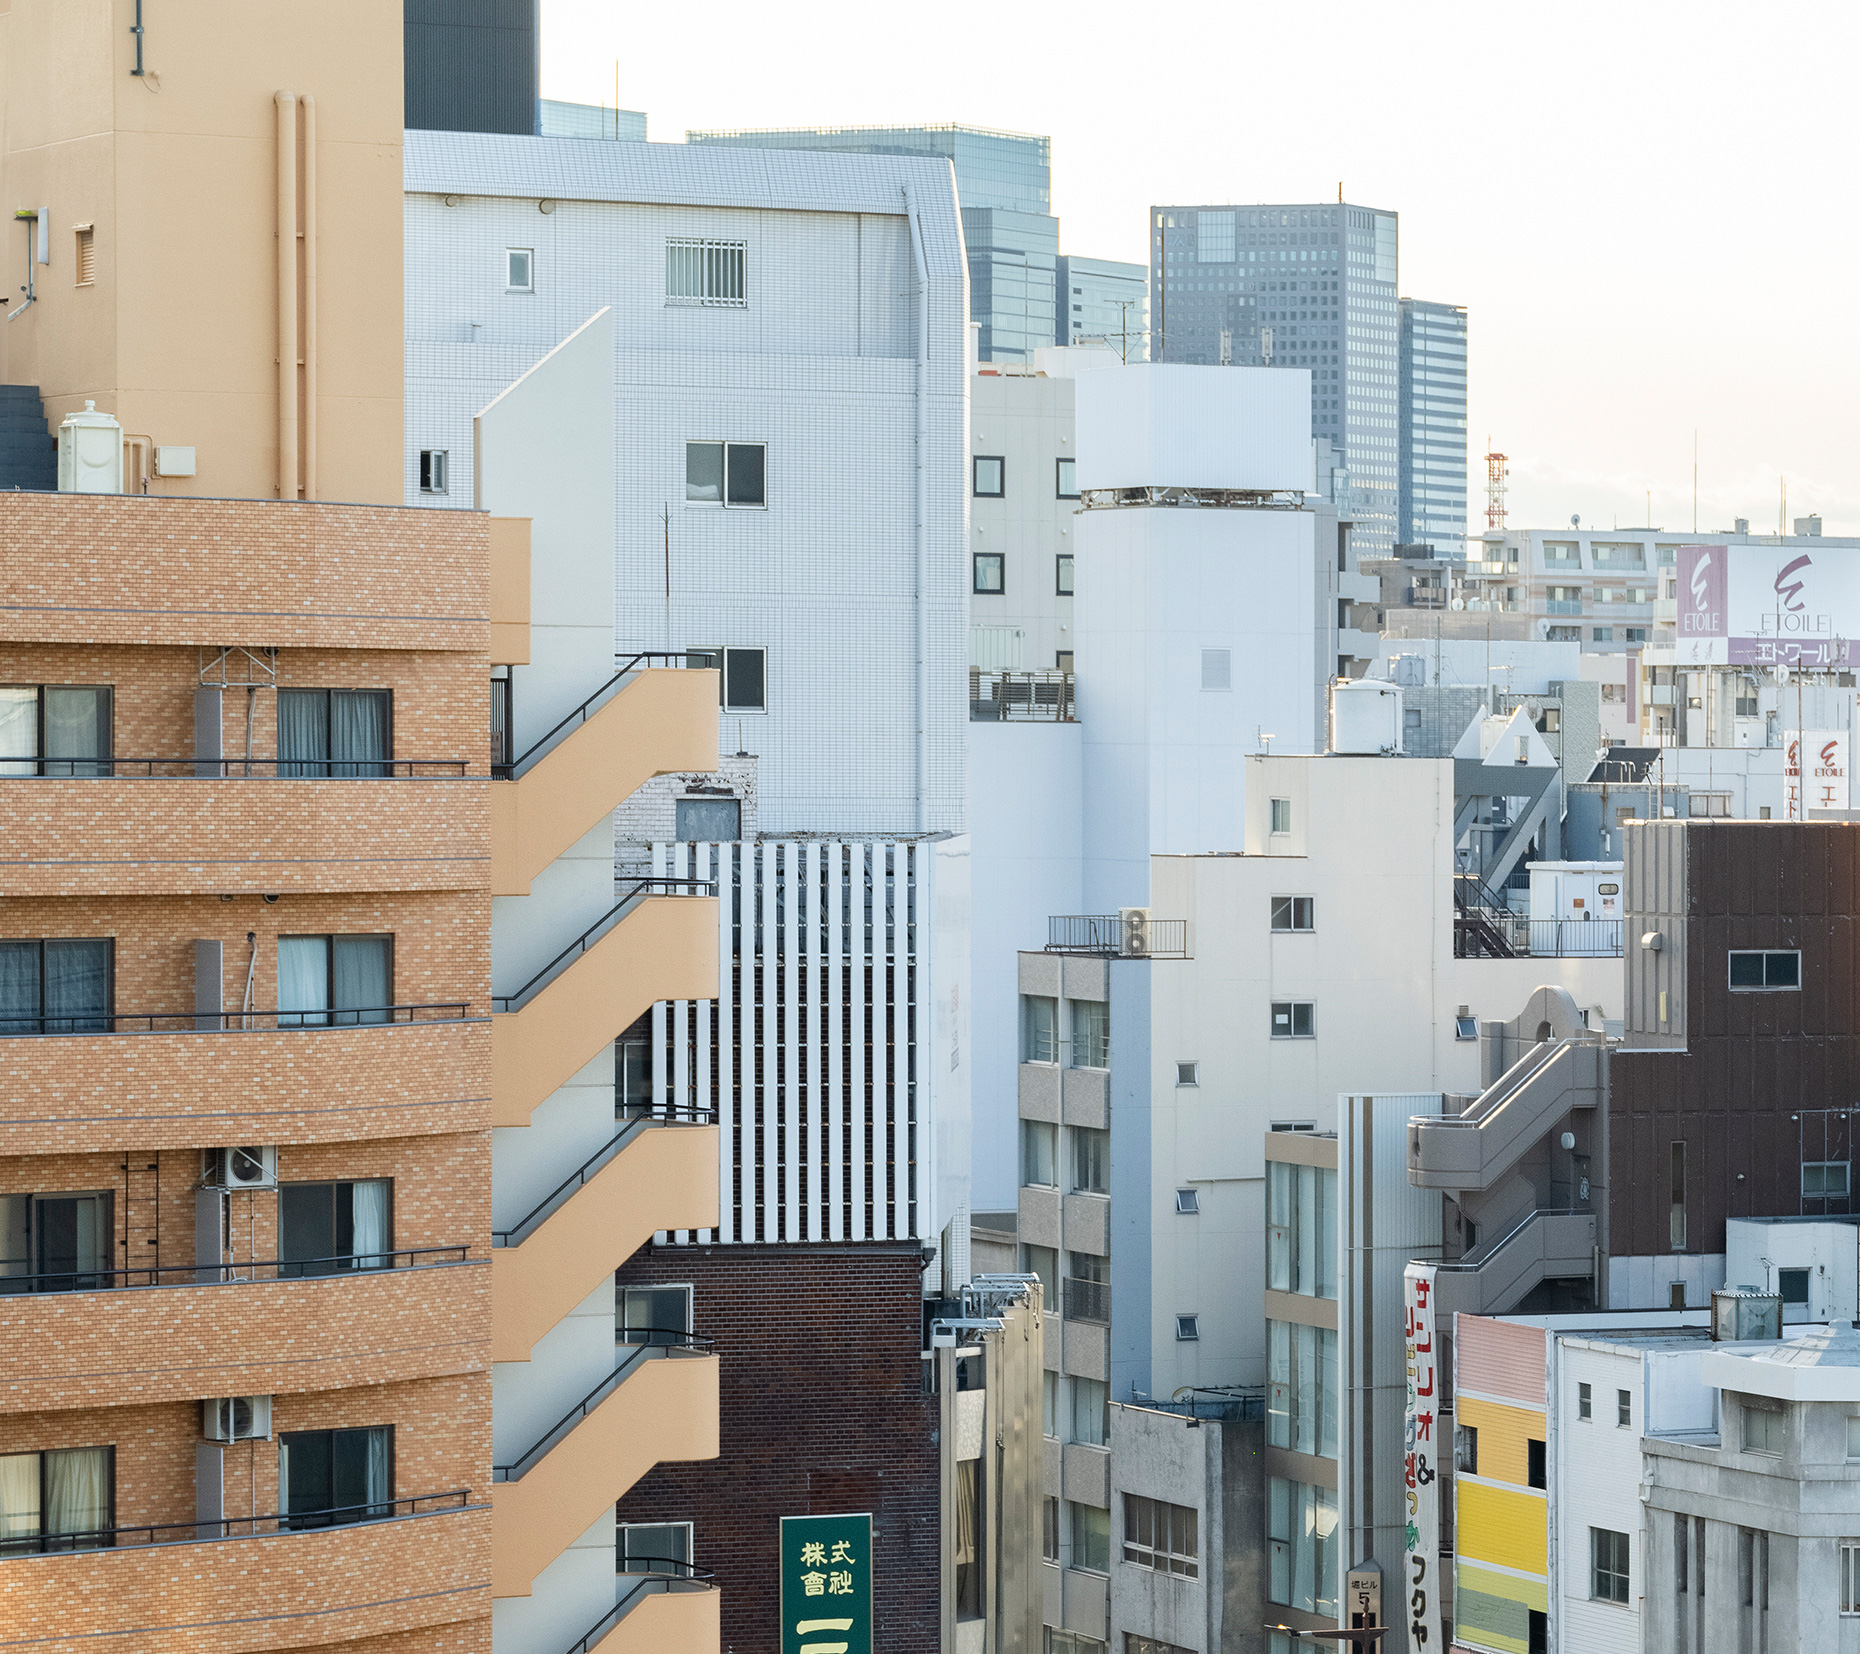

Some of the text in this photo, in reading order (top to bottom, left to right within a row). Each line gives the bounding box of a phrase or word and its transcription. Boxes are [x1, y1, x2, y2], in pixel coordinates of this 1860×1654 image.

[1684, 612, 1720, 632] ETOILE
[1761, 613, 1829, 632] ETOILE
[1754, 642, 1832, 663] エトワール
[1815, 768, 1846, 777] ETOILE
